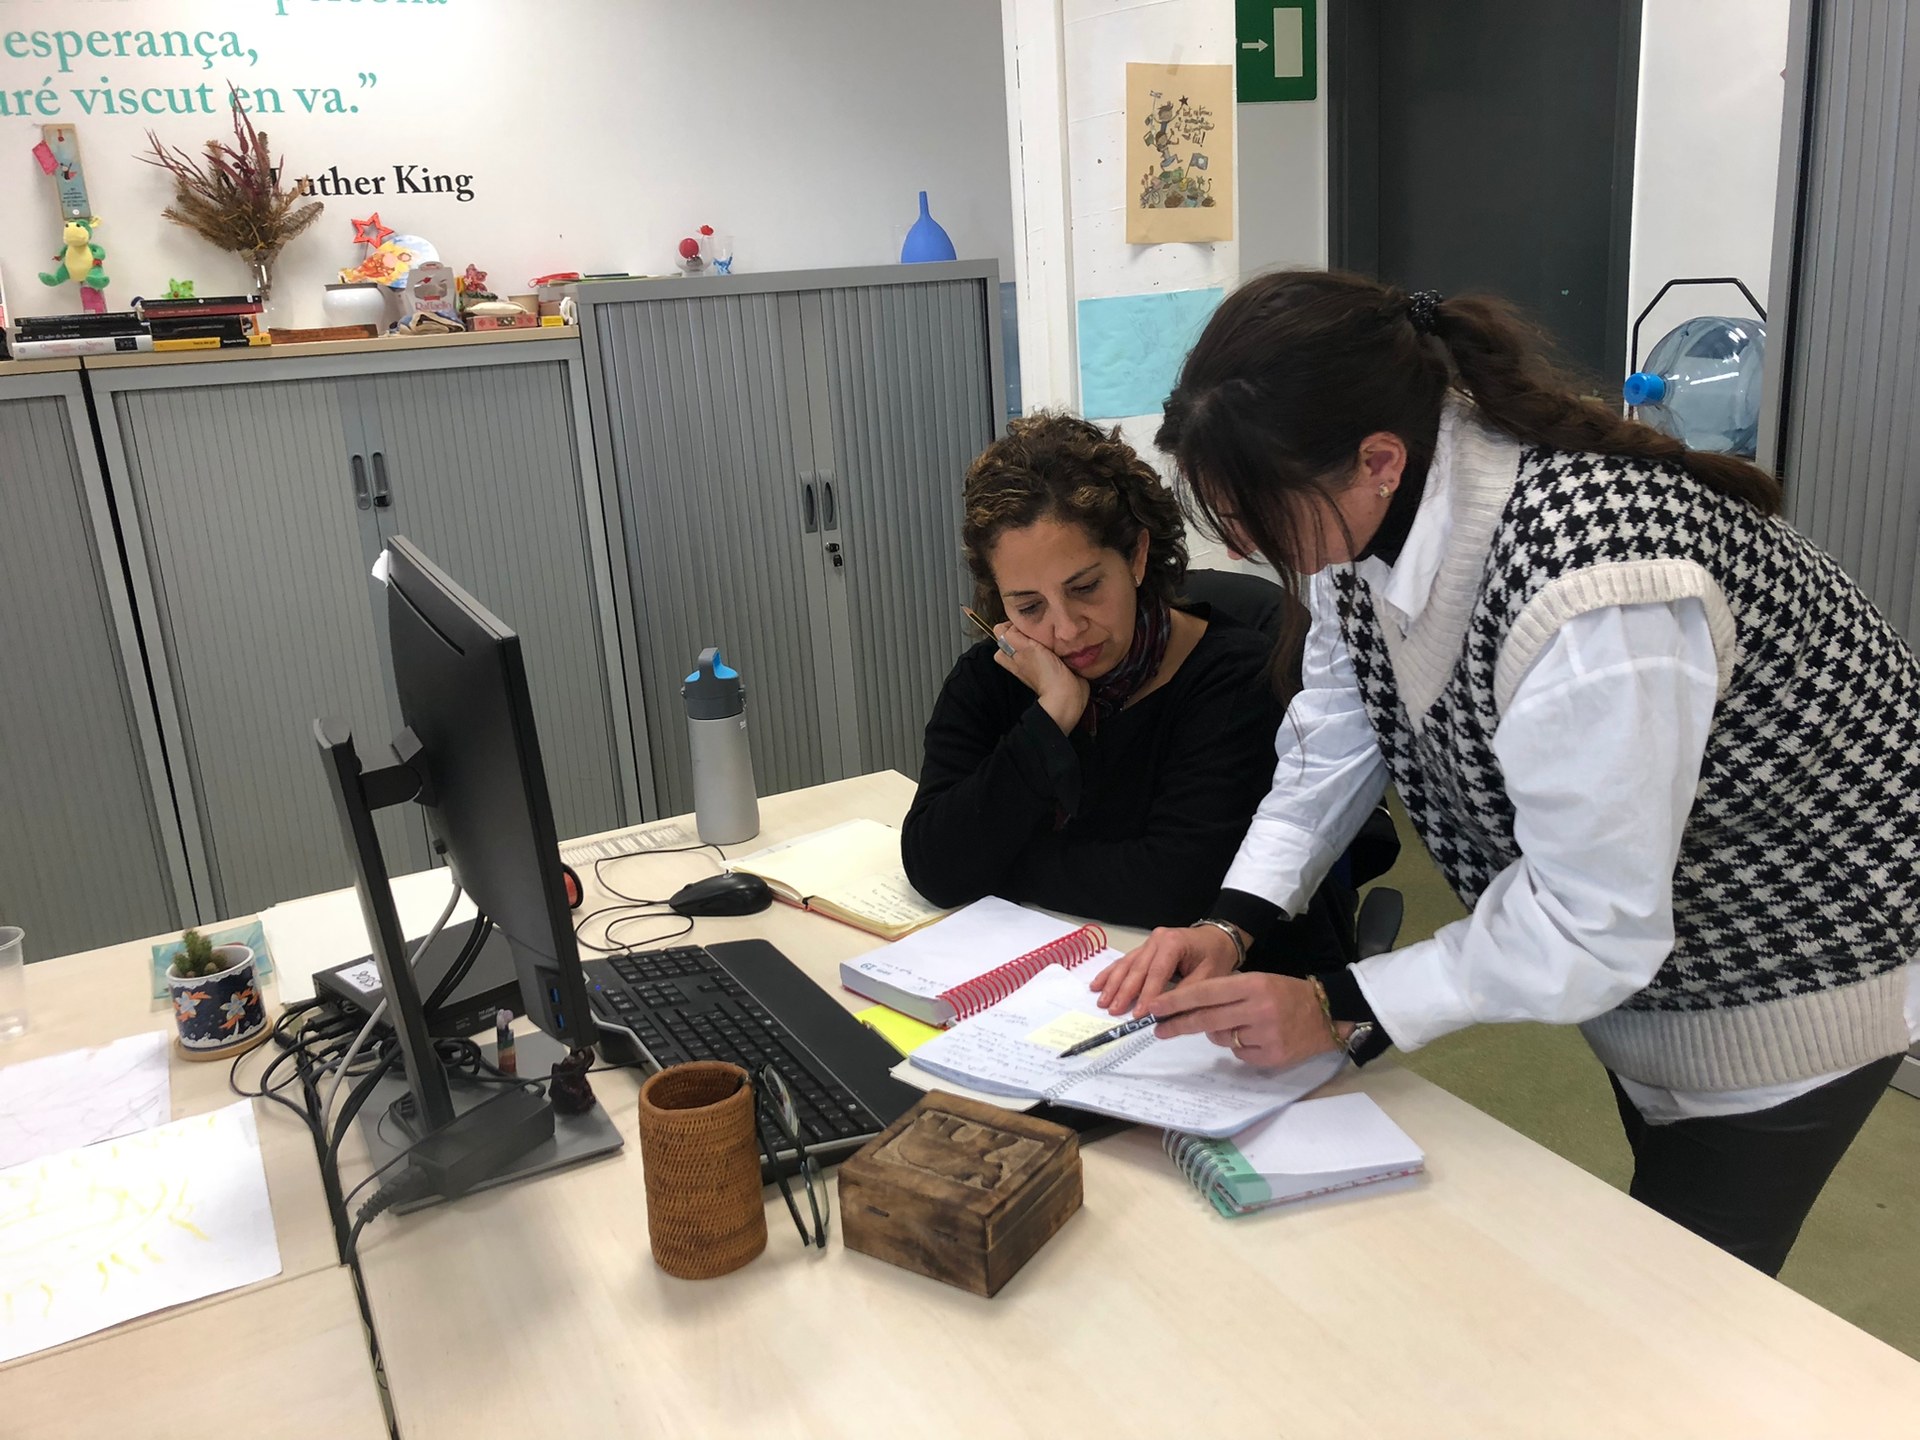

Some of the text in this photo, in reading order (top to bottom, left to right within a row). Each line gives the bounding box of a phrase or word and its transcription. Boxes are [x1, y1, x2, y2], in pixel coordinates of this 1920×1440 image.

[4, 29, 258, 73] esperança,
[70, 76, 216, 115] viscut
[228, 86, 285, 114] en
[392, 165, 475, 202] King
